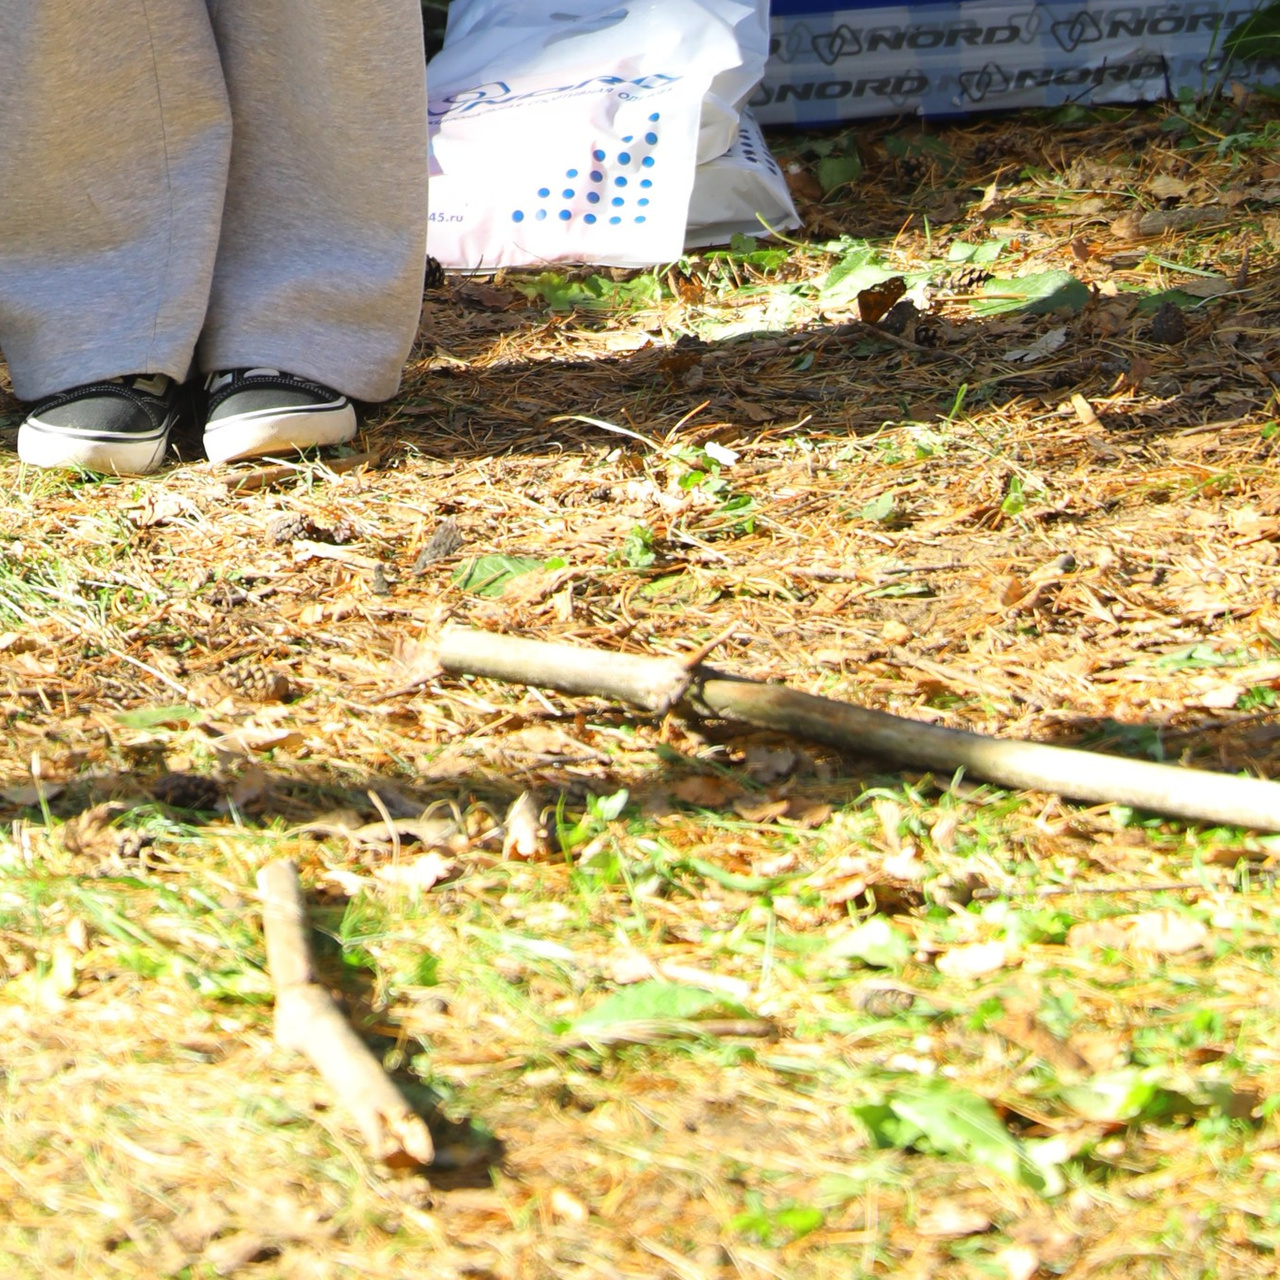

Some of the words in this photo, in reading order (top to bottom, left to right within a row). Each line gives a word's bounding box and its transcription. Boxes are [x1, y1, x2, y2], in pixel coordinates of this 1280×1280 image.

[866, 25, 1022, 52] NORD
[773, 75, 930, 103] NORD
[1014, 61, 1169, 90] NORD
